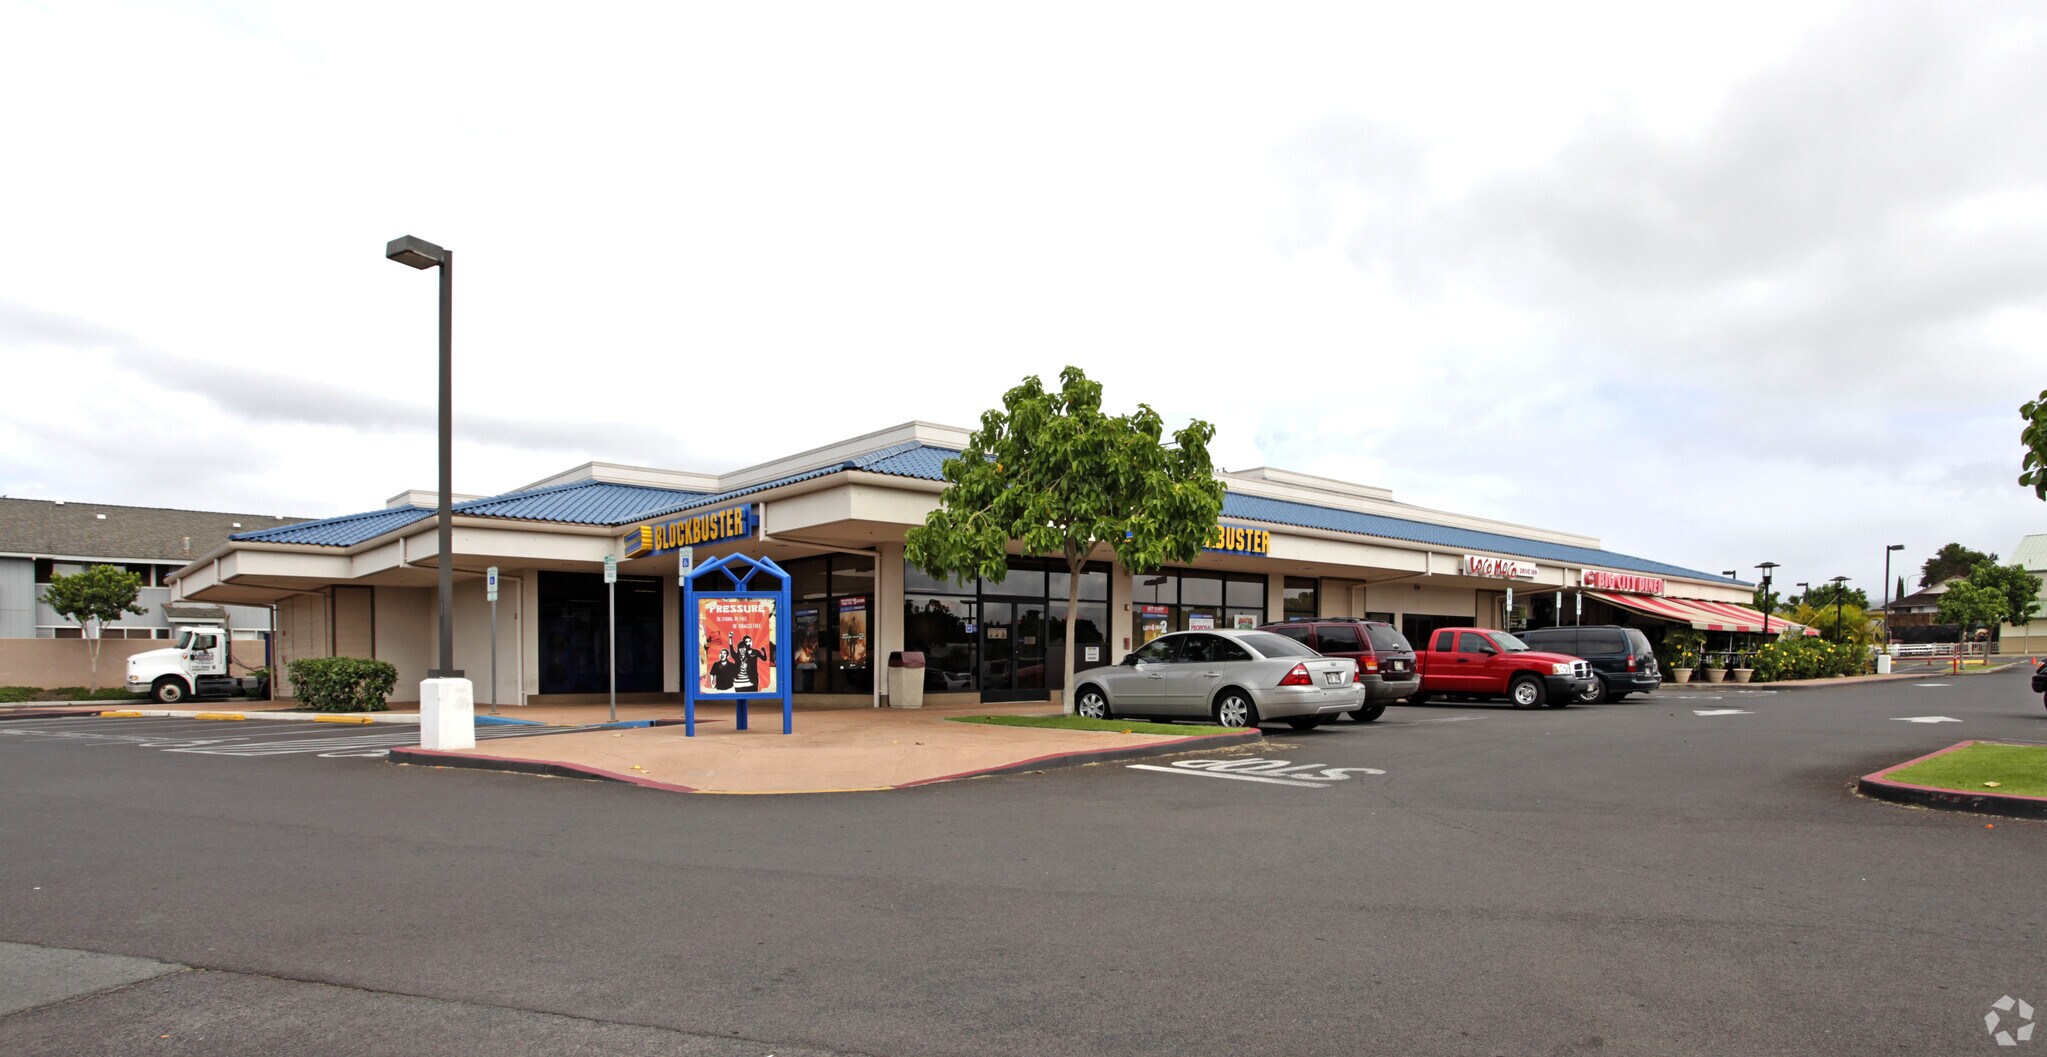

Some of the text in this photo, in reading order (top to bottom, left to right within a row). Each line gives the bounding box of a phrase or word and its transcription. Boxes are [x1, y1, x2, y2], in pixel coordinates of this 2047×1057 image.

[655, 507, 744, 551] BLOCKBUSTER
[1596, 571, 1664, 594] BIG CITY DINER
[709, 604, 766, 614] PRESSURE
[1171, 757, 1387, 781] STOP
